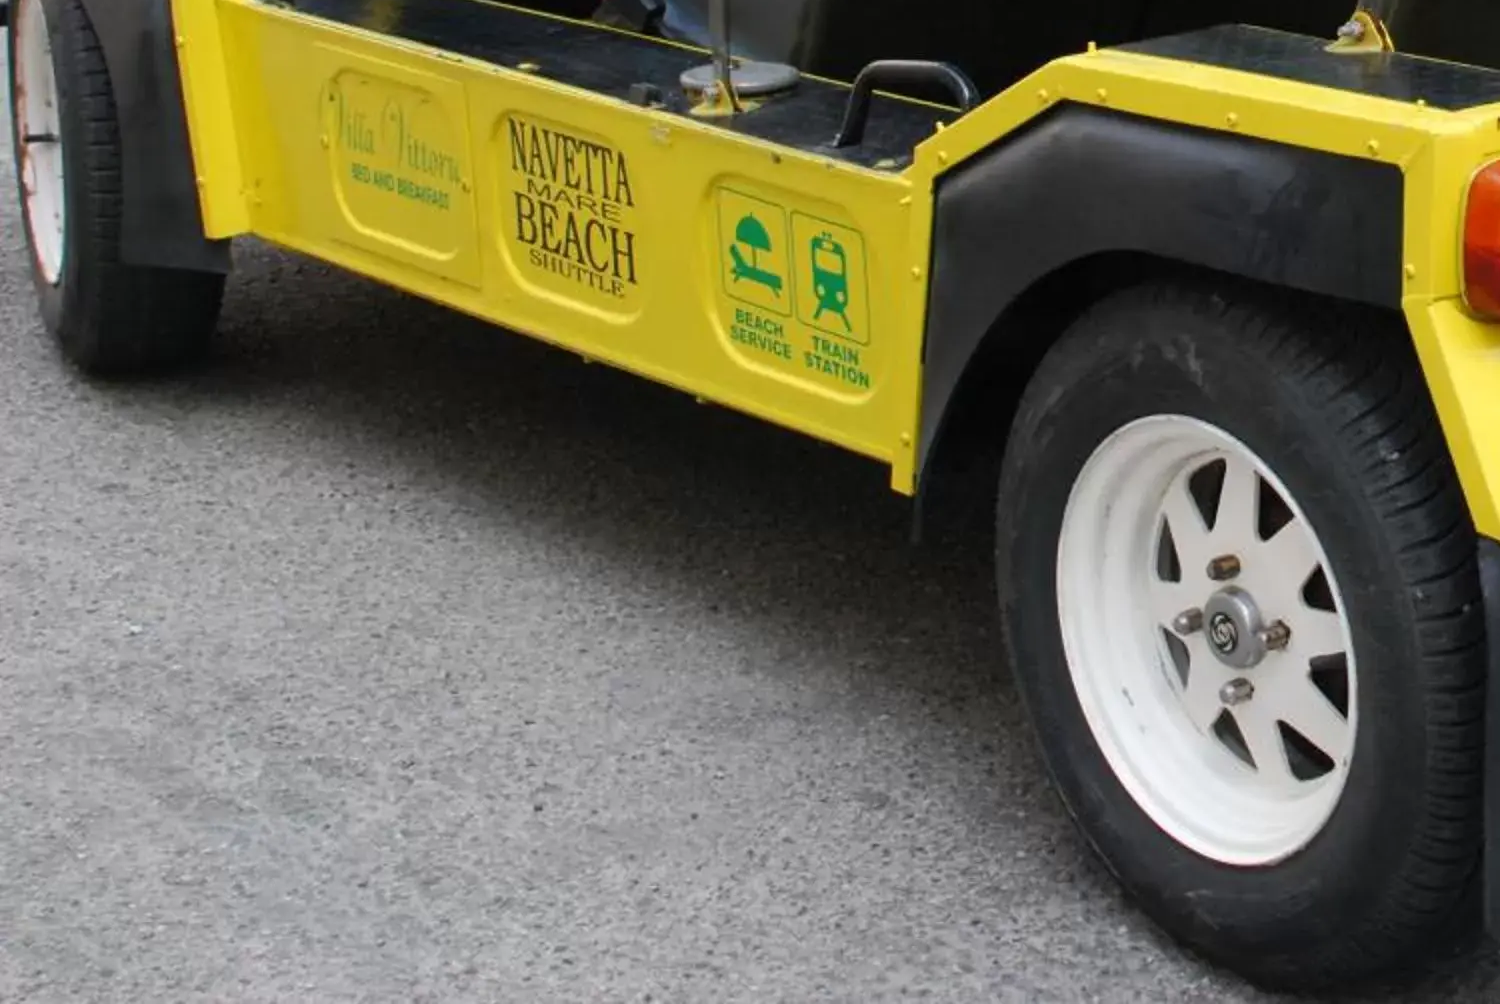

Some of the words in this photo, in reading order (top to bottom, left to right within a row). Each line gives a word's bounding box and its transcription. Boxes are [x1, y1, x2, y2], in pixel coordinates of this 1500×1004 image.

[509, 117, 635, 207] NAVETTA
[527, 178, 621, 224] MARE
[514, 191, 638, 284] BEACH
[529, 248, 625, 298] SHUTTLE
[730, 325, 792, 359] SERVICE
[735, 308, 784, 338] BEACH
[804, 351, 870, 388] STATION
[811, 335, 859, 365] TRAIN
